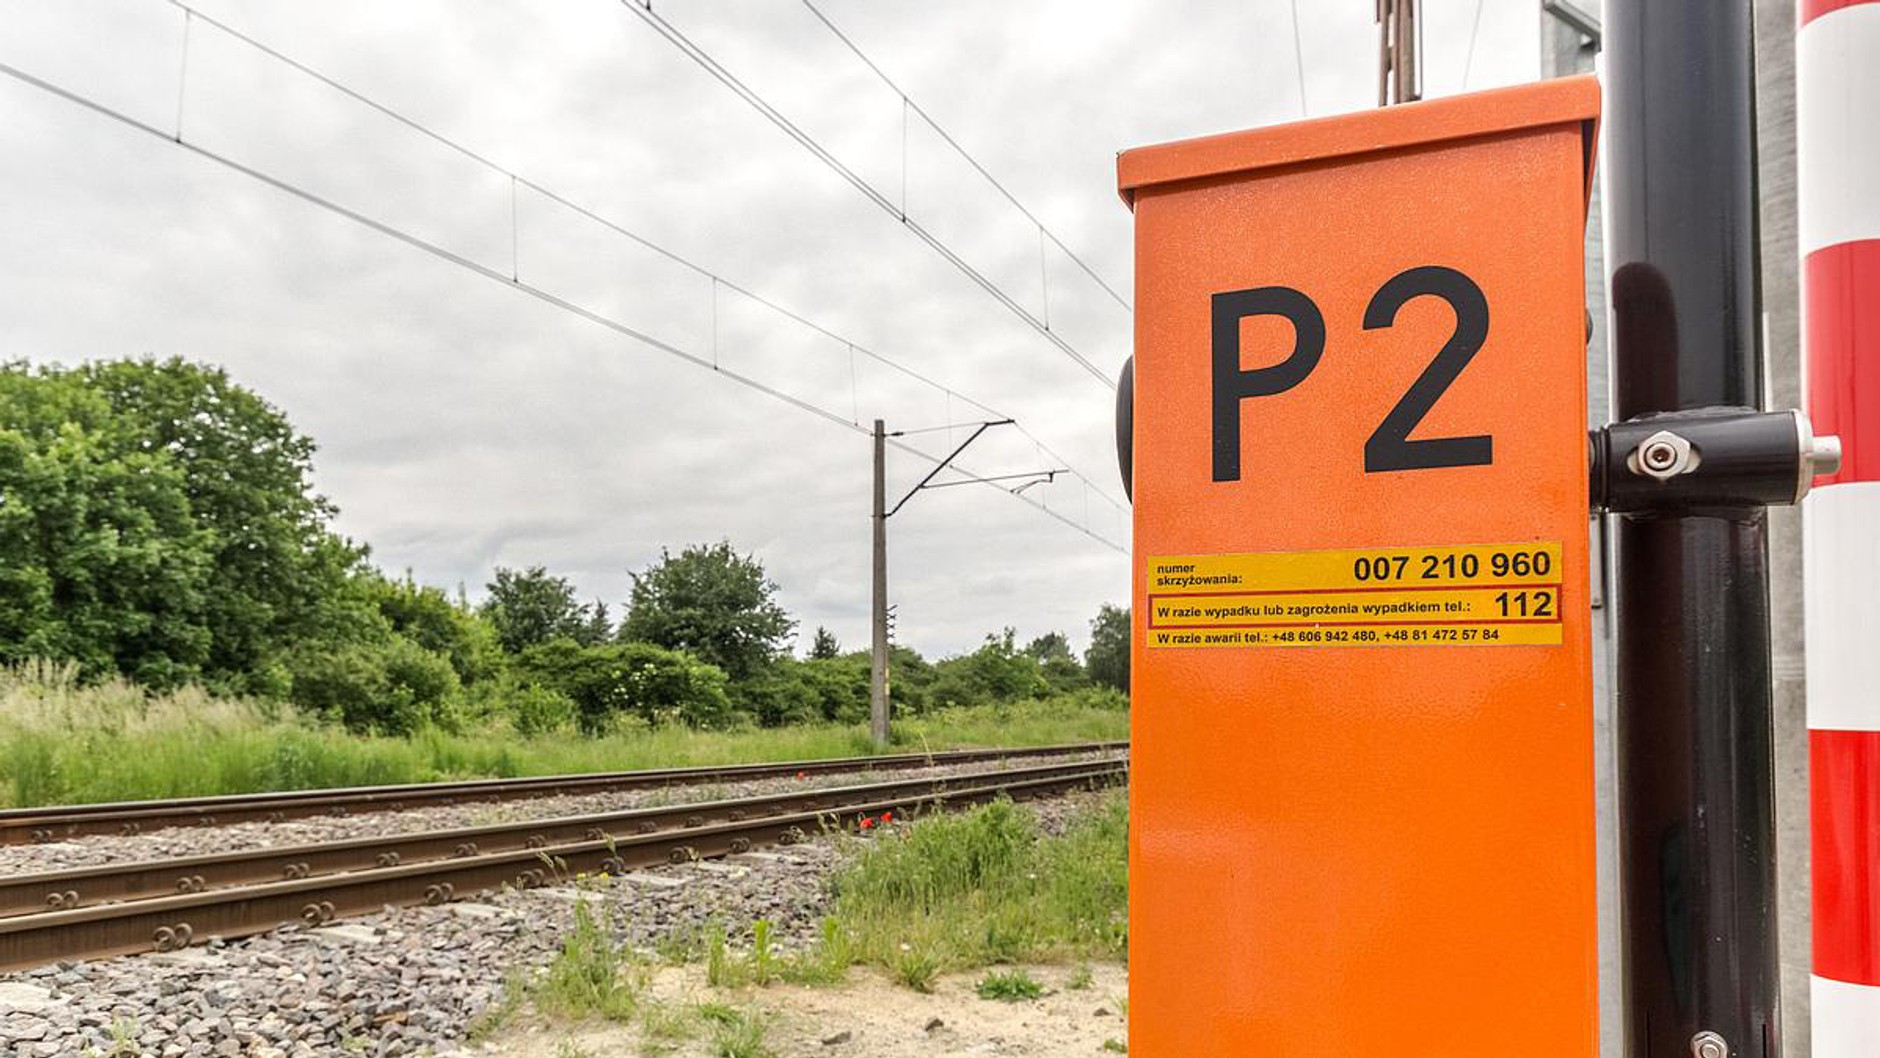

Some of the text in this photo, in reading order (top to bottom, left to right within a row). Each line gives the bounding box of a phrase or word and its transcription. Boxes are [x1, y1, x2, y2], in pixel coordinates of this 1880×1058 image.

[1211, 265, 1493, 483] P2
[1157, 565, 1195, 574] numer
[1354, 551, 1551, 581] 007 210 960
[1157, 575, 1242, 587] skrzyżowania:
[1158, 601, 1470, 618] W razie wypadku lub zagrożenia wypadkiem tel.:
[1495, 591, 1552, 617] 112
[1157, 629, 1499, 644] W razie awarii tel.: +48 606 942 480, +48 81 472 57 84
